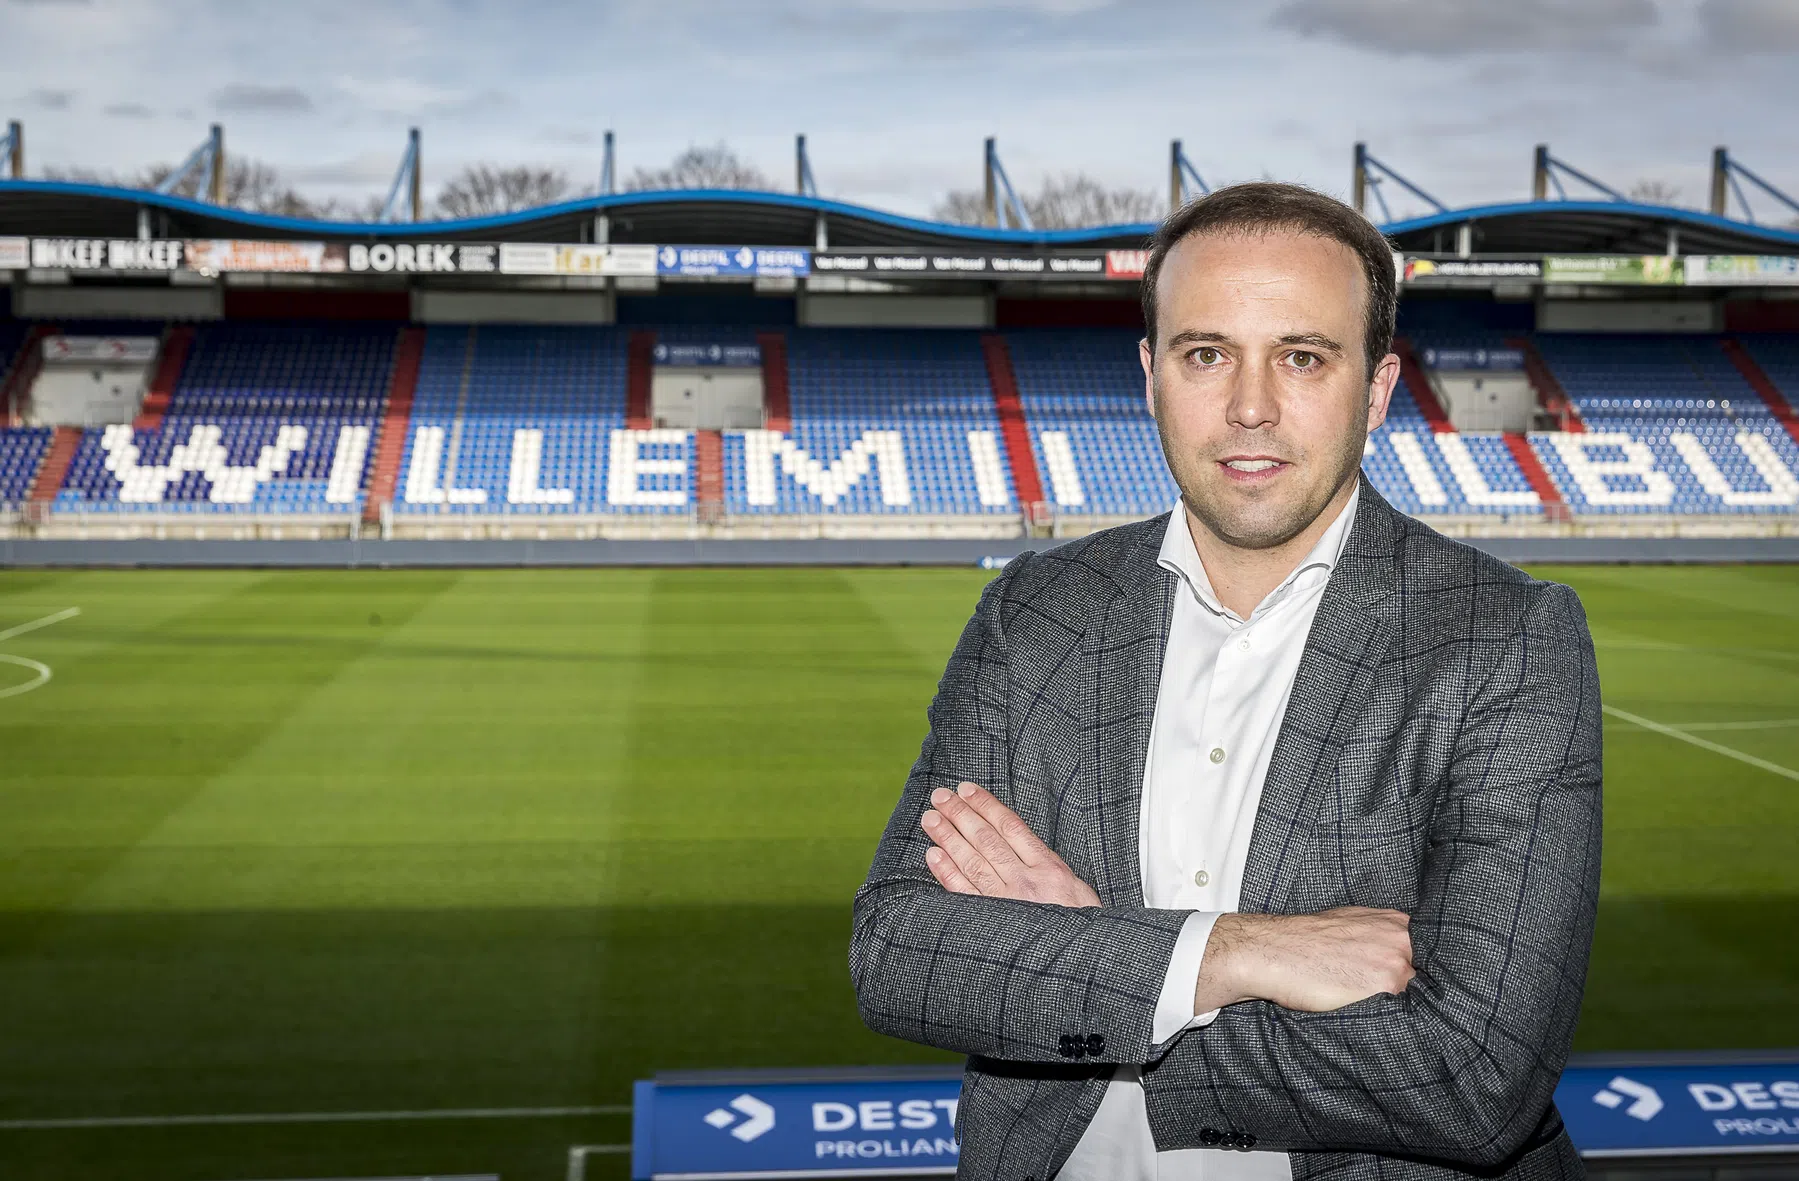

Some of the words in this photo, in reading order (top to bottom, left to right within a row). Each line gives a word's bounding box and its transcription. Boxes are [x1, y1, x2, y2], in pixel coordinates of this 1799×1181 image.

[350, 243, 456, 272] BOREK
[101, 424, 911, 505] WILLEM
[968, 430, 1084, 505] II
[1363, 431, 1799, 505] ILBU
[1687, 1081, 1799, 1111] DES
[811, 1099, 959, 1131] DEST
[815, 1138, 959, 1159] PROLIAN
